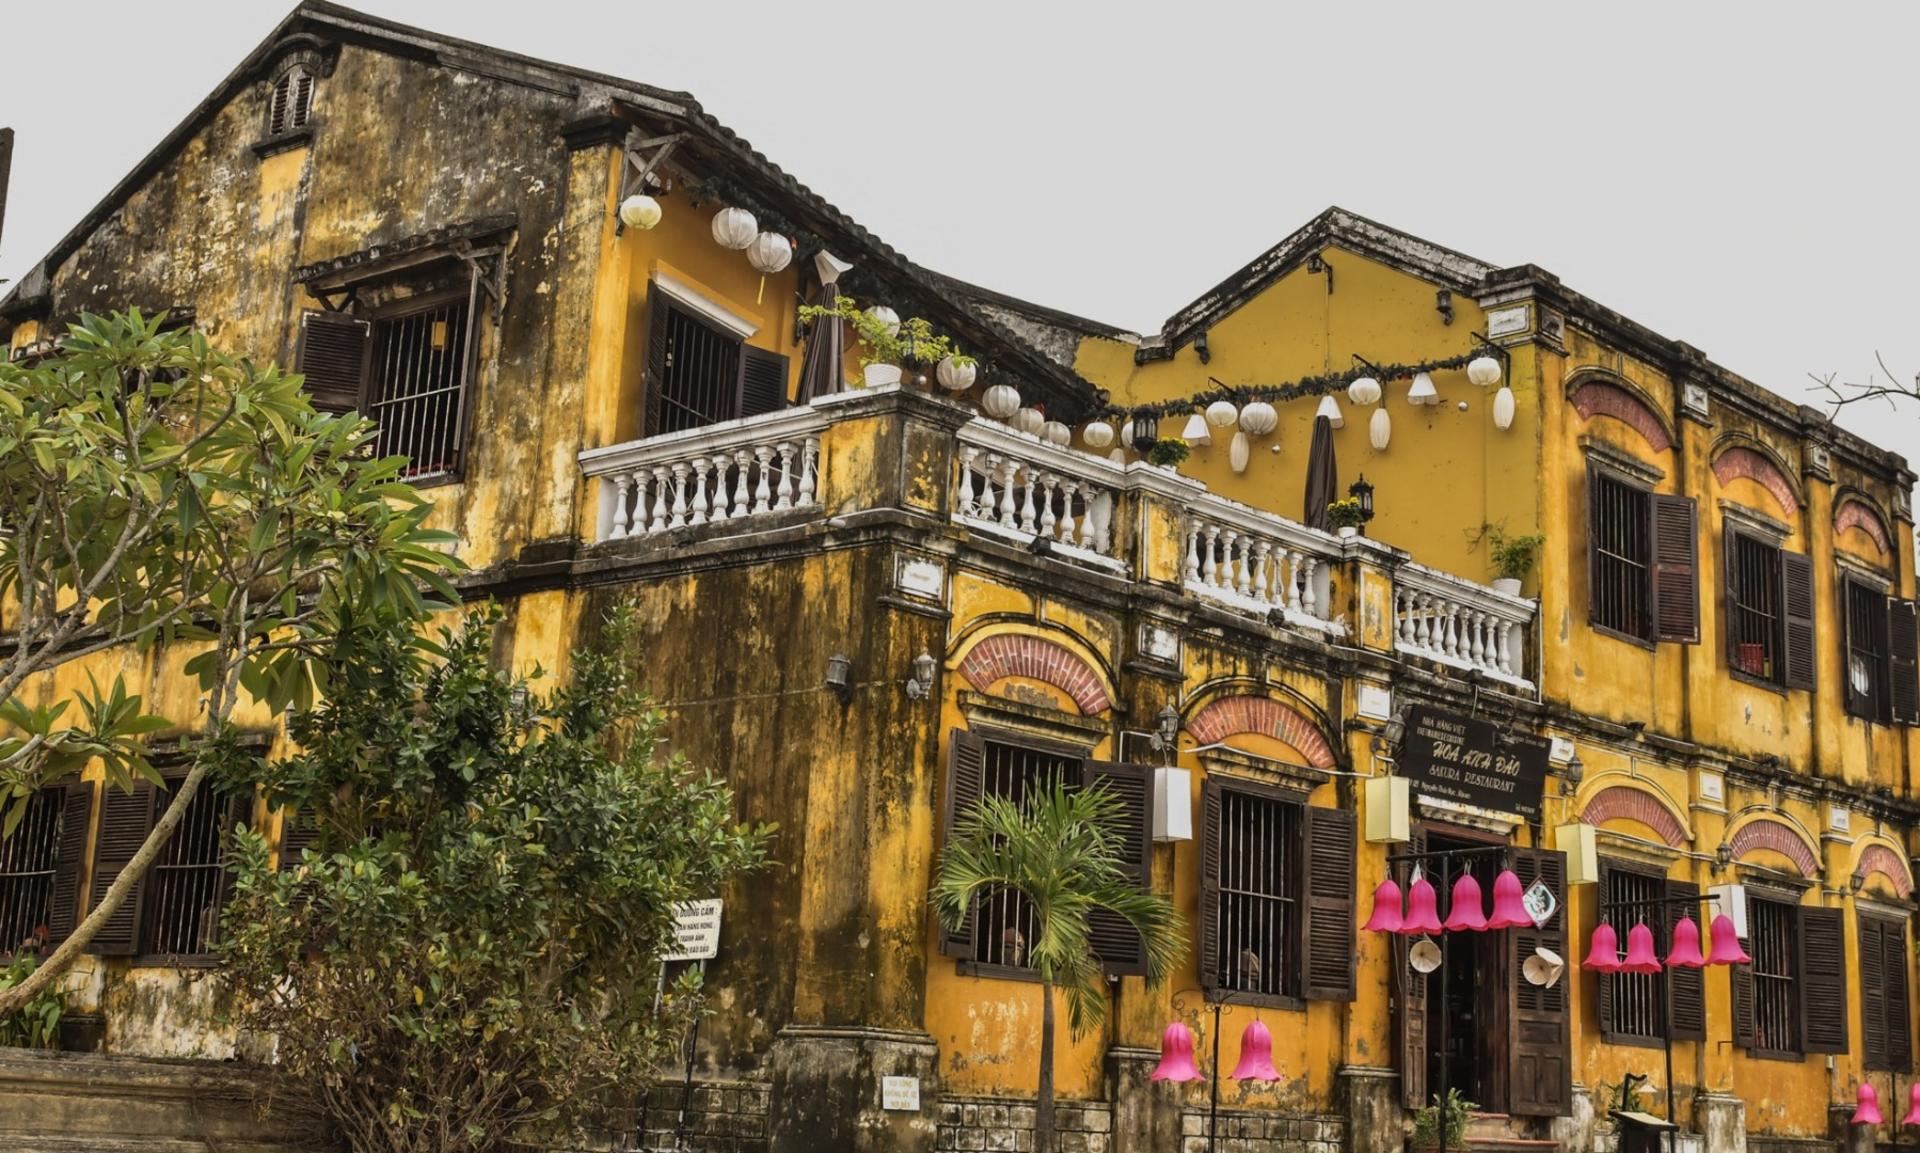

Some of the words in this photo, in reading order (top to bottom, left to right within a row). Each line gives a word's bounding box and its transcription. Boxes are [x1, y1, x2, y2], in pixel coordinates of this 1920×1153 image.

[1432, 741, 1459, 761] HOA
[1461, 750, 1493, 770] ANH
[1429, 764, 1460, 782] SAKURA
[1464, 772, 1516, 793] RESTAURANT
